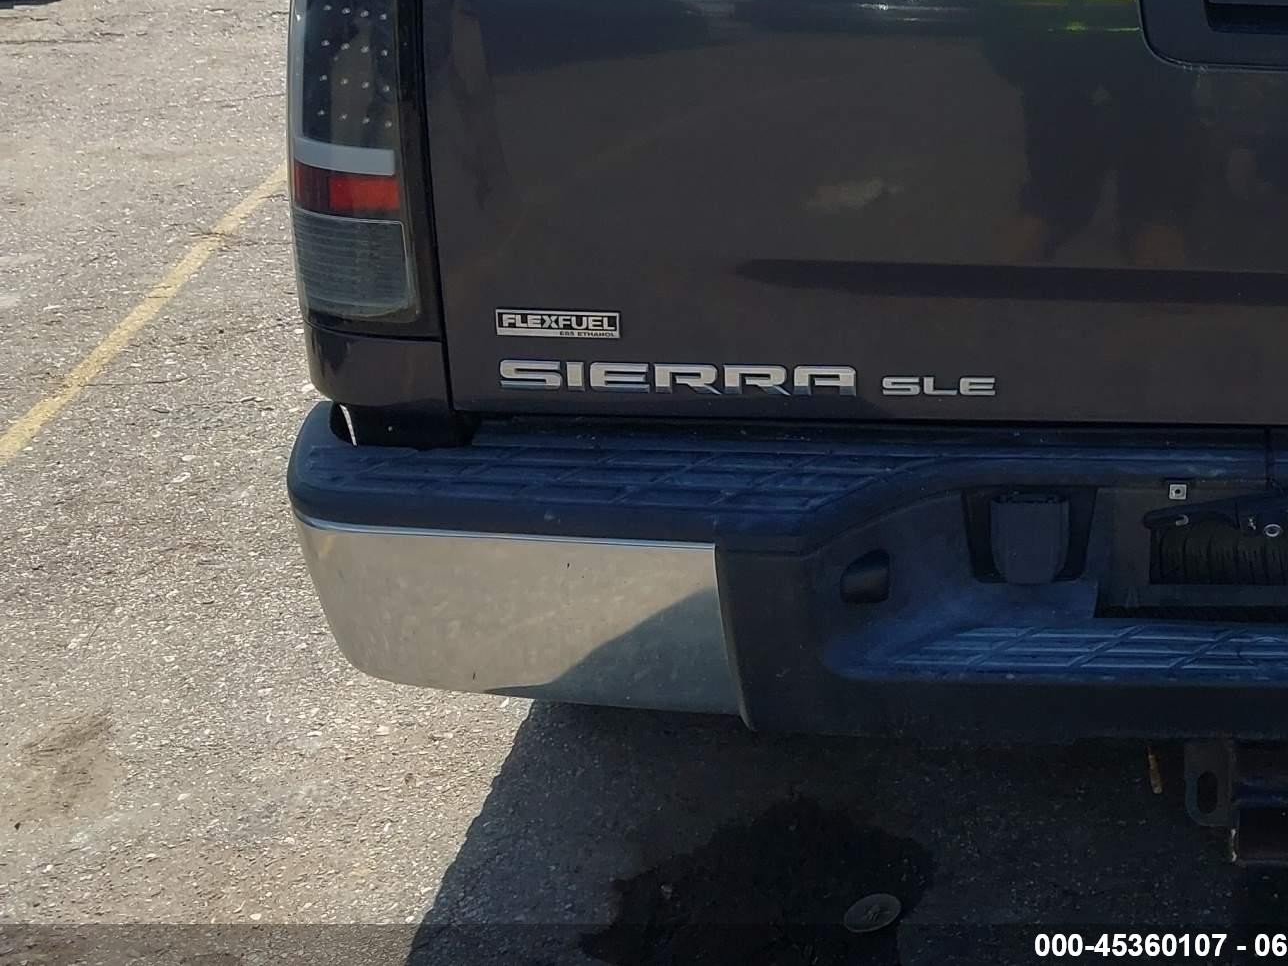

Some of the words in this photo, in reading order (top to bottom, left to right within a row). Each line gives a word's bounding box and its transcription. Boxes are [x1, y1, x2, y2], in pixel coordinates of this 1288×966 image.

[501, 313, 616, 330] FLEXFUEL
[499, 359, 858, 397] SIERRA
[881, 376, 997, 397] SLE
